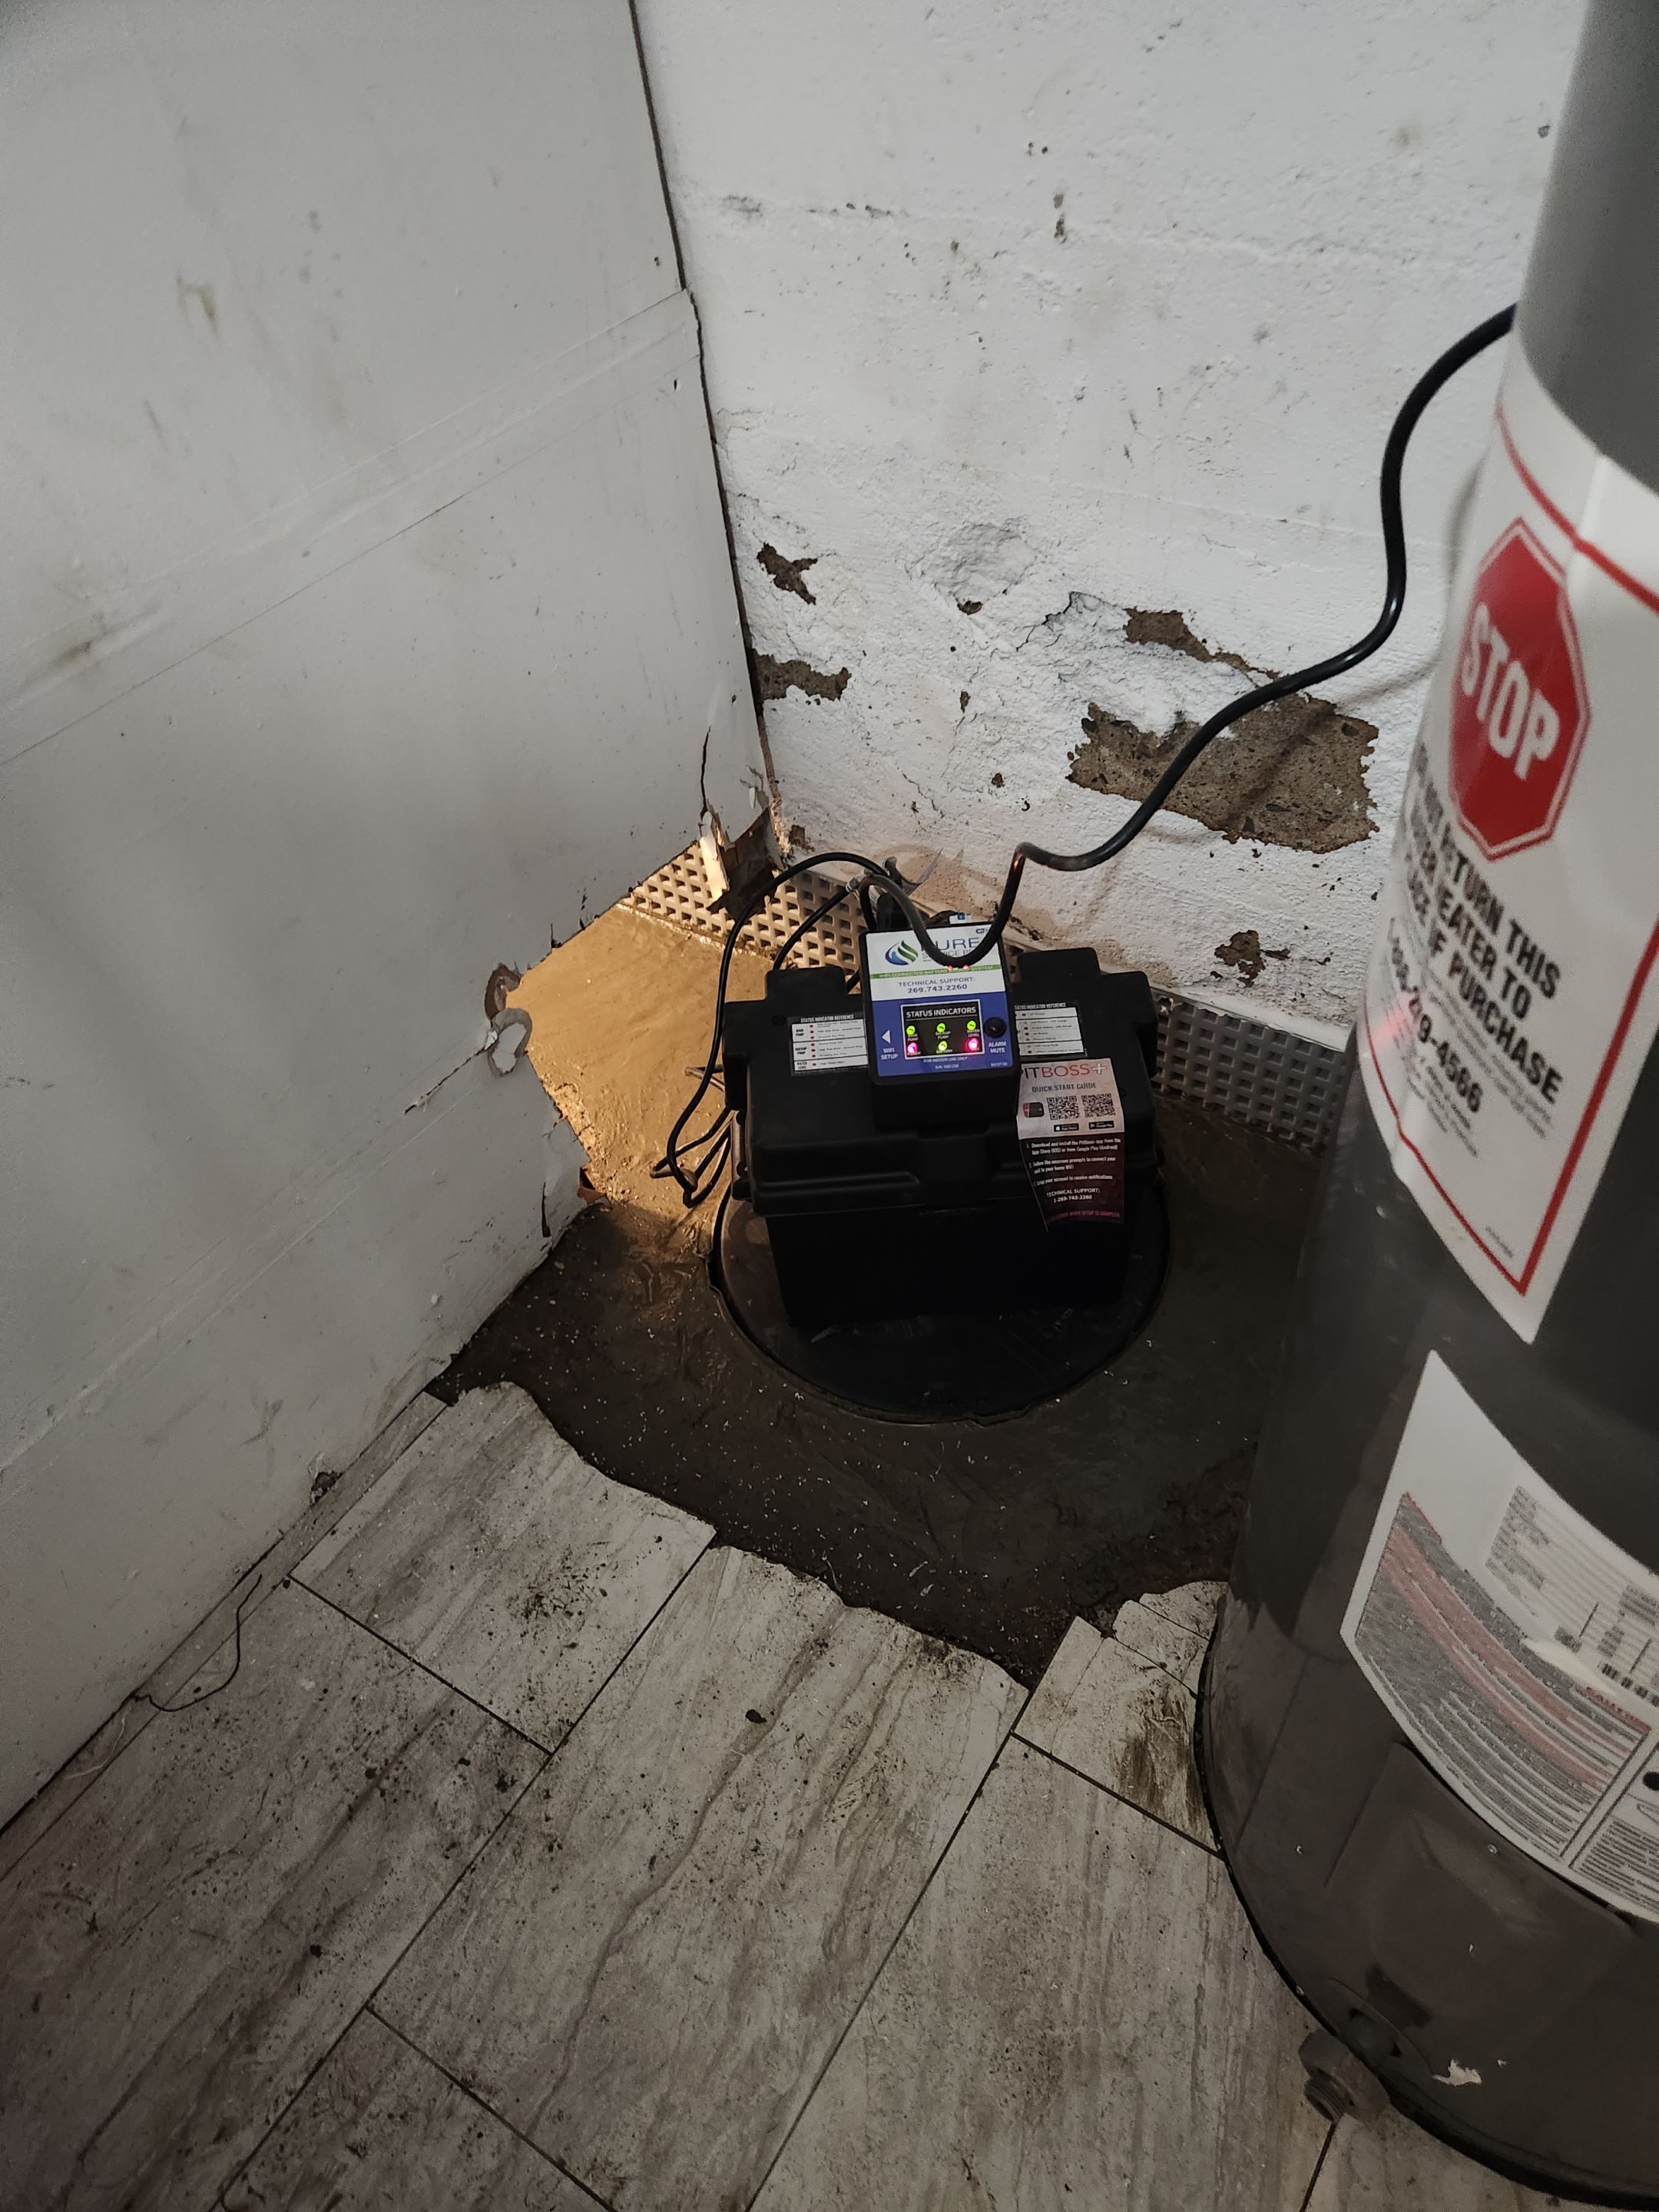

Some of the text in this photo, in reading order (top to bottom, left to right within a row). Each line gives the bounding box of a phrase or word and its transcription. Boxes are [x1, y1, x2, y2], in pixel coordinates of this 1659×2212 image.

[1462, 601, 1561, 781] STOP
[922, 937, 980, 952] URE
[1506, 918, 1561, 999] THIS
[898, 979, 938, 987] TECHNICAL
[907, 984, 968, 994] 269.743.2260
[1501, 965, 1532, 1020] TO
[906, 1007, 976, 1018] STATUS INDICATORS
[1449, 950, 1562, 1104] PURCHASE
